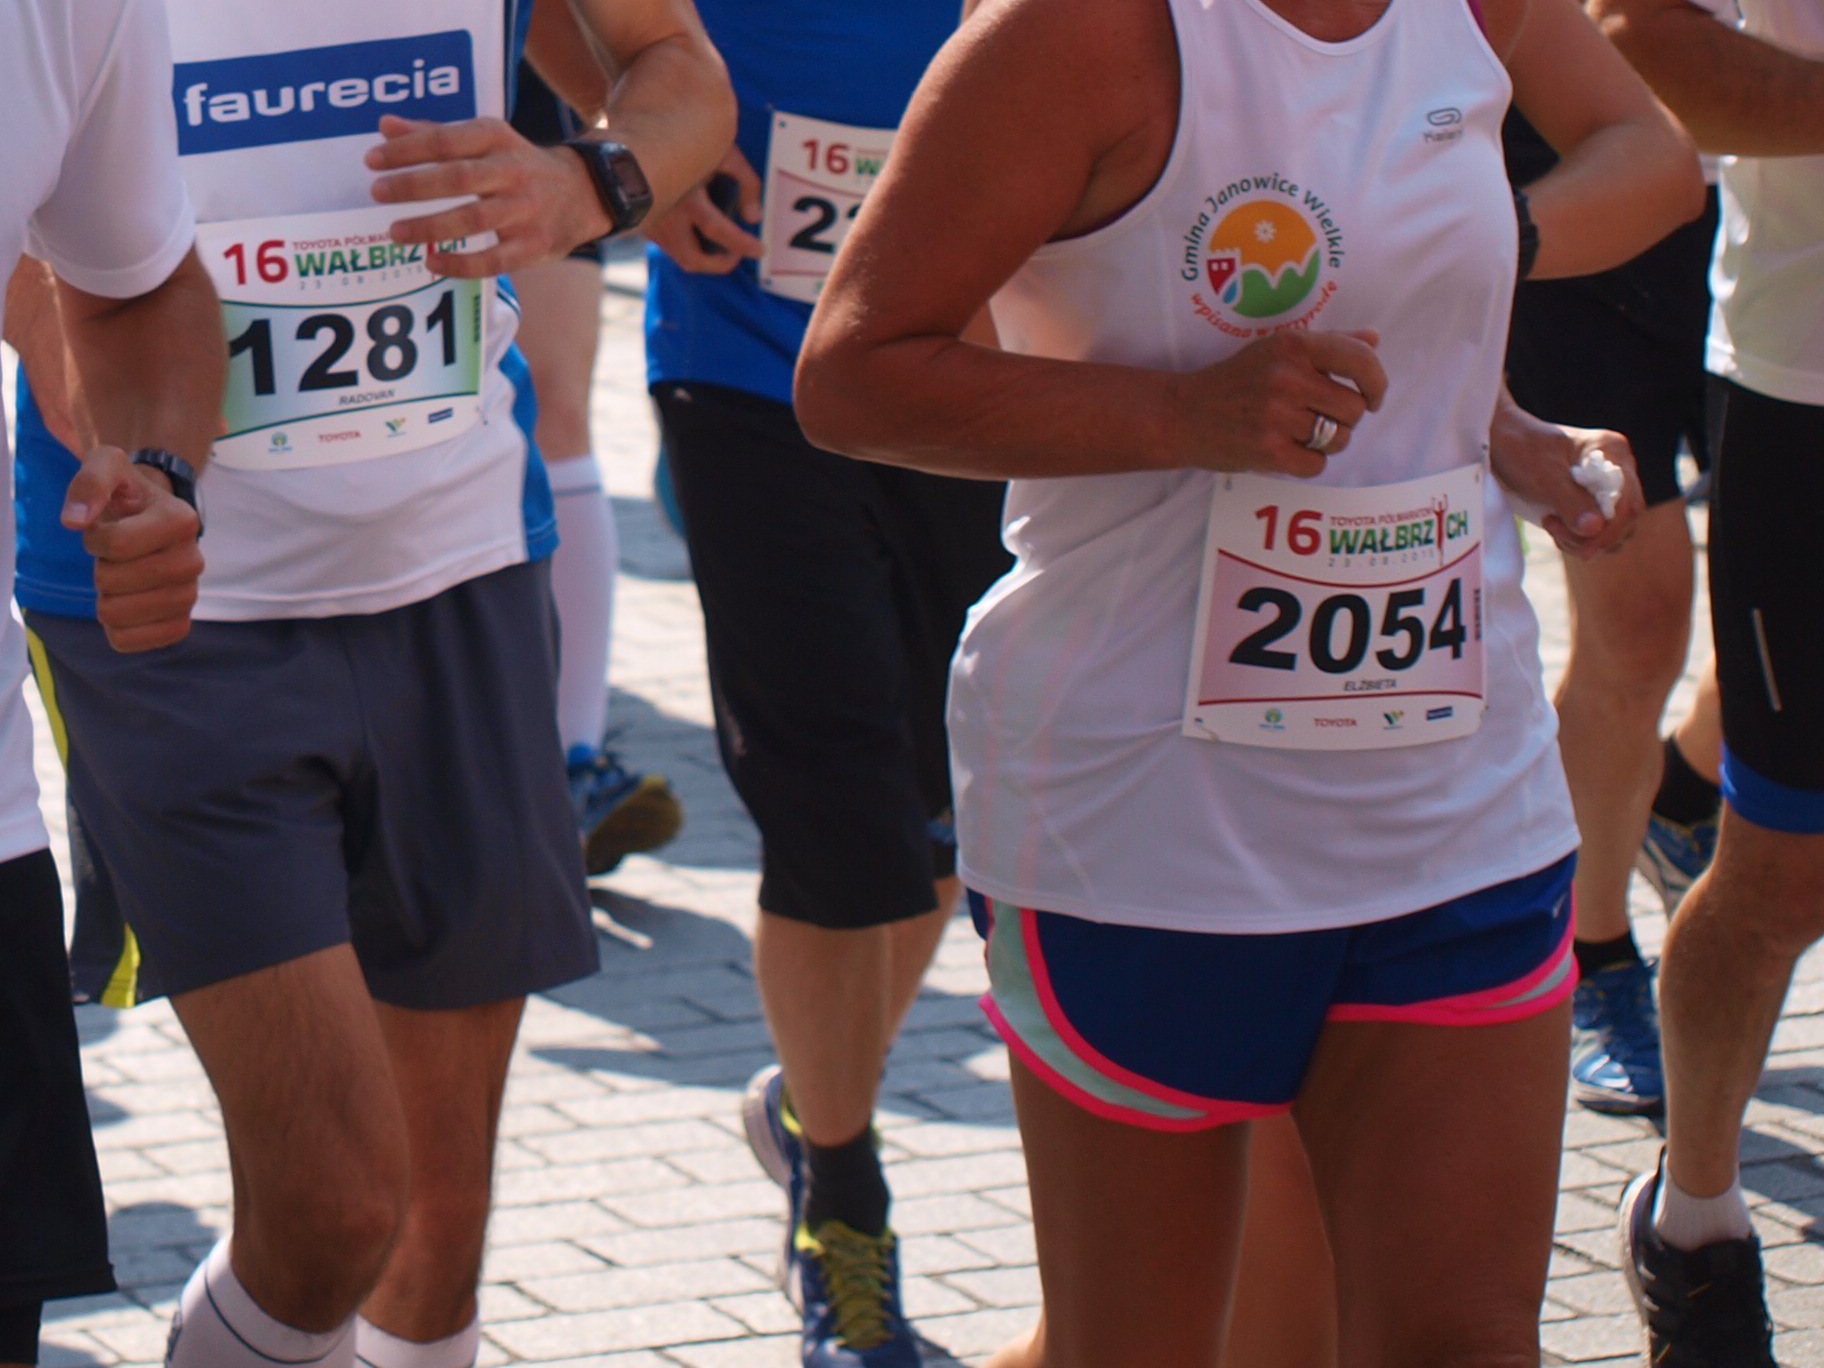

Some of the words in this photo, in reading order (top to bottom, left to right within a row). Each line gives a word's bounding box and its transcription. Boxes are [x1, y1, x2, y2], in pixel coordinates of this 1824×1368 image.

[183, 59, 460, 126] faurecia
[801, 139, 850, 174] 16
[1181, 212, 1211, 282] Gmina
[1205, 172, 1299, 213] Janowice
[1303, 190, 1345, 269] Wielkie
[223, 240, 288, 285] 16
[229, 289, 457, 396] 1281
[318, 430, 362, 443] TOYOTA
[1255, 504, 1323, 555] 16
[1330, 516, 1375, 527] TOYOTA
[1228, 577, 1467, 674] 2054
[1313, 717, 1358, 728] TOYOTA
